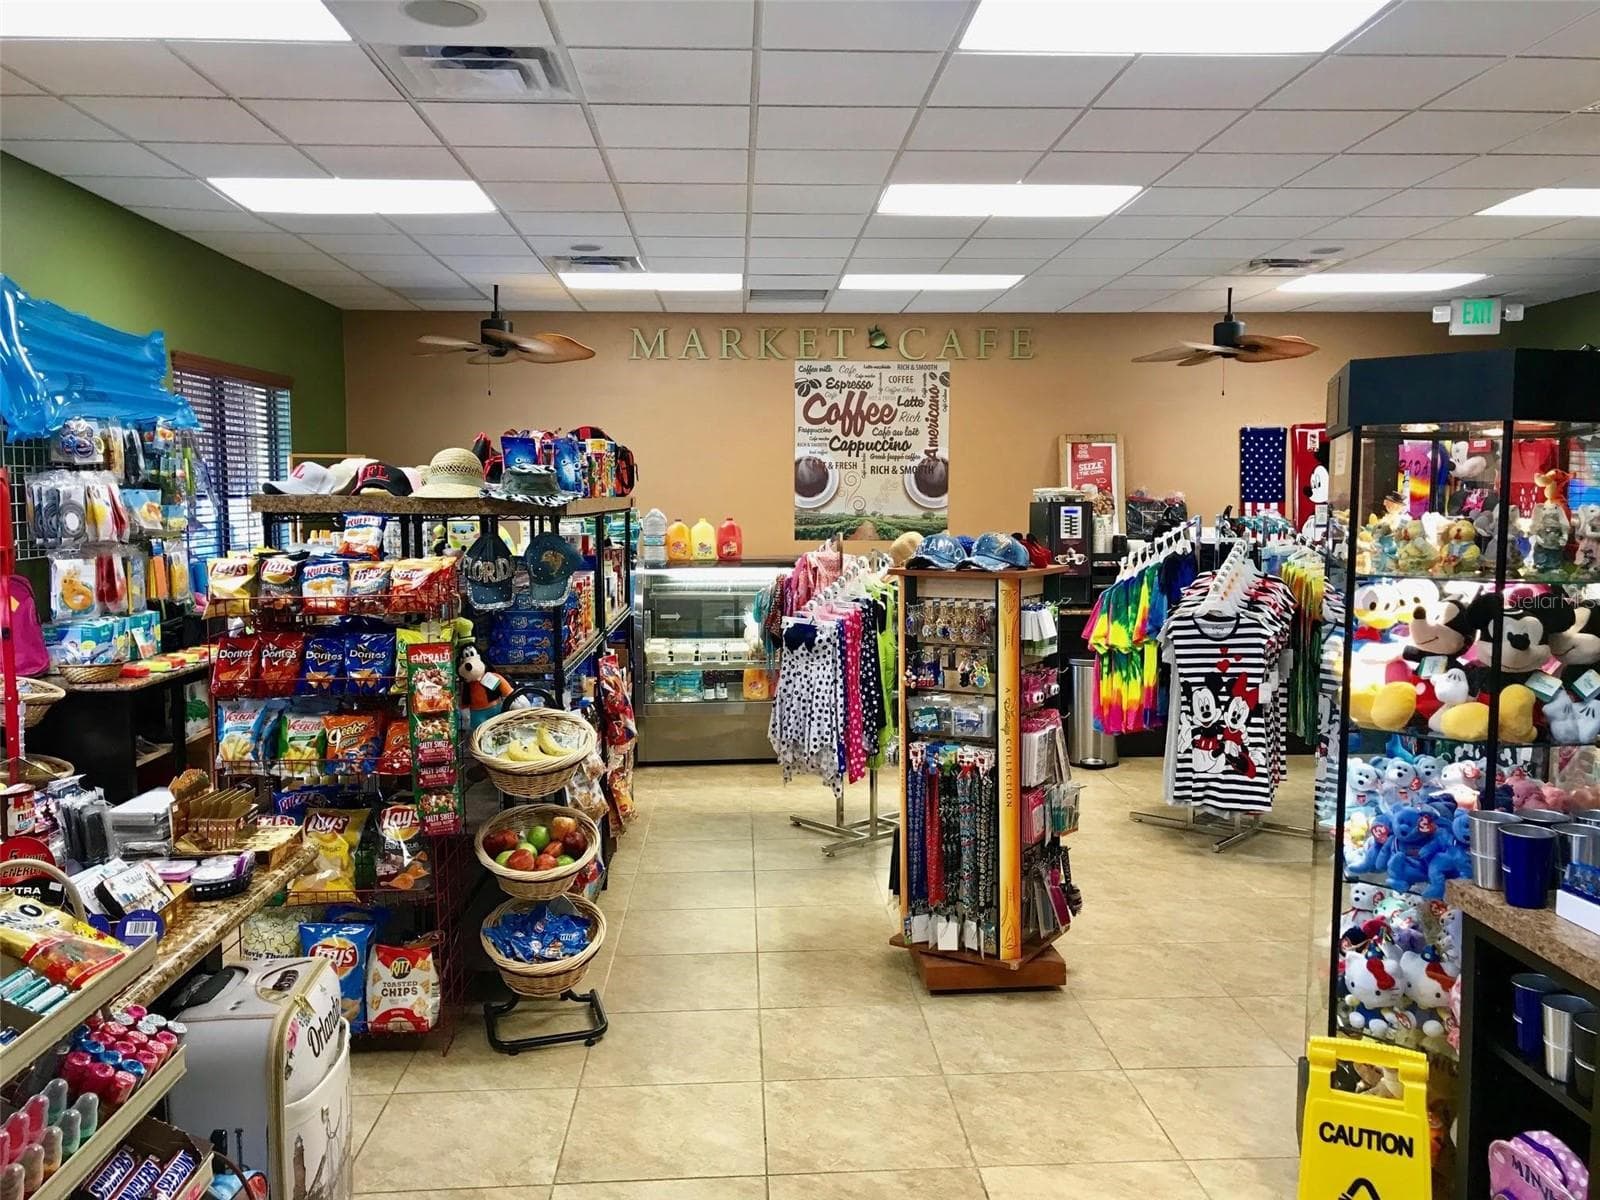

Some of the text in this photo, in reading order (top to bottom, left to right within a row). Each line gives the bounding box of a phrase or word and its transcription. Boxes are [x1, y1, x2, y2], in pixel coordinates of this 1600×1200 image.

[1462, 301, 1494, 325] EXIT
[629, 327, 1034, 361] MARKET CAFE
[825, 377, 874, 394] Espresso
[888, 376, 914, 384] COFFEE
[897, 395, 925, 408] Latte
[803, 391, 898, 437] Coffee
[899, 411, 921, 422] Rich
[924, 384, 941, 461] Americano
[829, 436, 913, 458] Cappuccino
[365, 465, 391, 480] FL
[828, 462, 833, 470] &
[835, 462, 858, 471] FRESH
[870, 465, 936, 475] RICH & SMOOTH
[1078, 462, 1105, 471] SEIZE
[304, 564, 344, 579] RUFFLES
[219, 649, 253, 661] Doritos
[262, 648, 297, 661] Doritos
[306, 651, 344, 663] Doritos
[350, 648, 388, 661] Doritos
[410, 651, 450, 664] EMERALD
[1005, 739, 1014, 808] COLLECTION
[0, 887, 41, 895] EXTRA
[391, 962, 411, 976] RITZ
[381, 988, 418, 997] CHIPS
[307, 995, 342, 1058] Orlando
[1318, 1121, 1414, 1158] CAUTION
